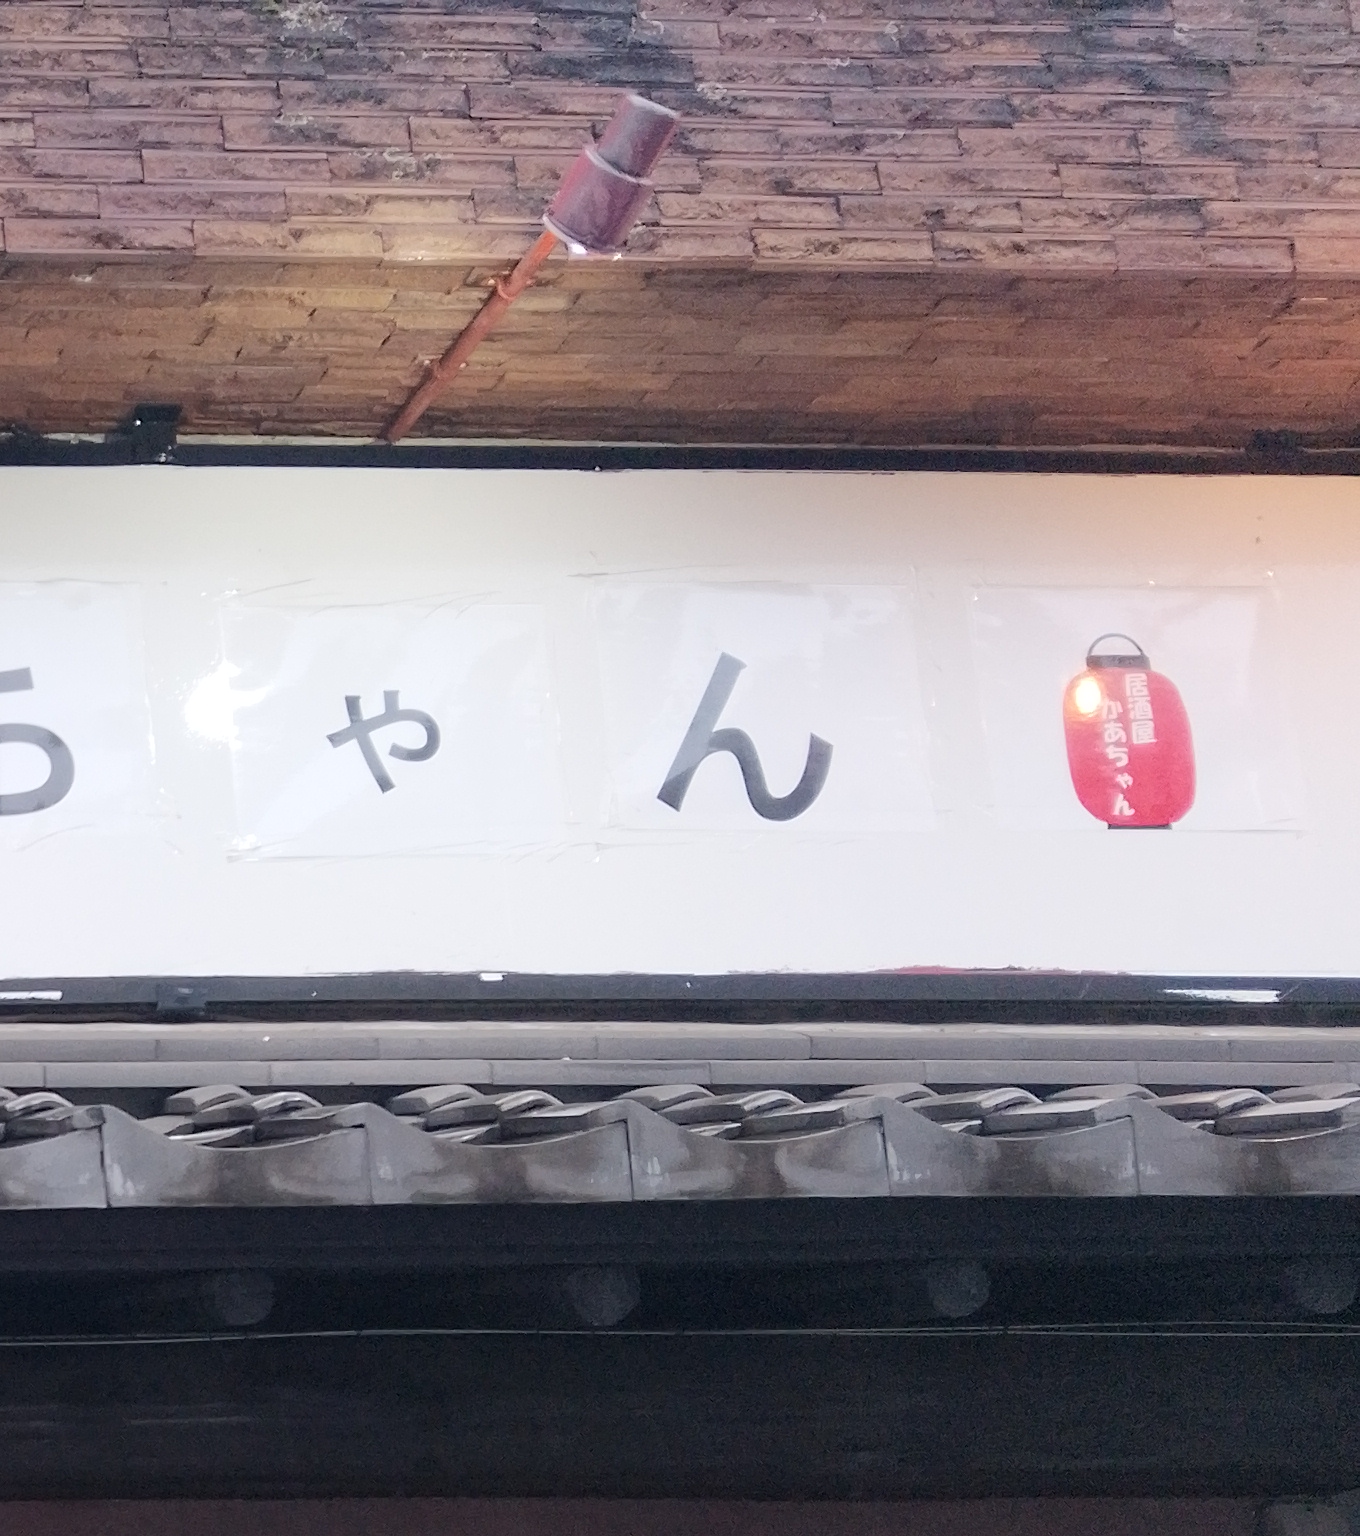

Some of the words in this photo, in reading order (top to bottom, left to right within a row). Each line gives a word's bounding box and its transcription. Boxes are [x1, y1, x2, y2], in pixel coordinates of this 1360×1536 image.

[1125, 672, 1157, 744] 居酒屋
[1102, 698, 1136, 817] かあちゃん
